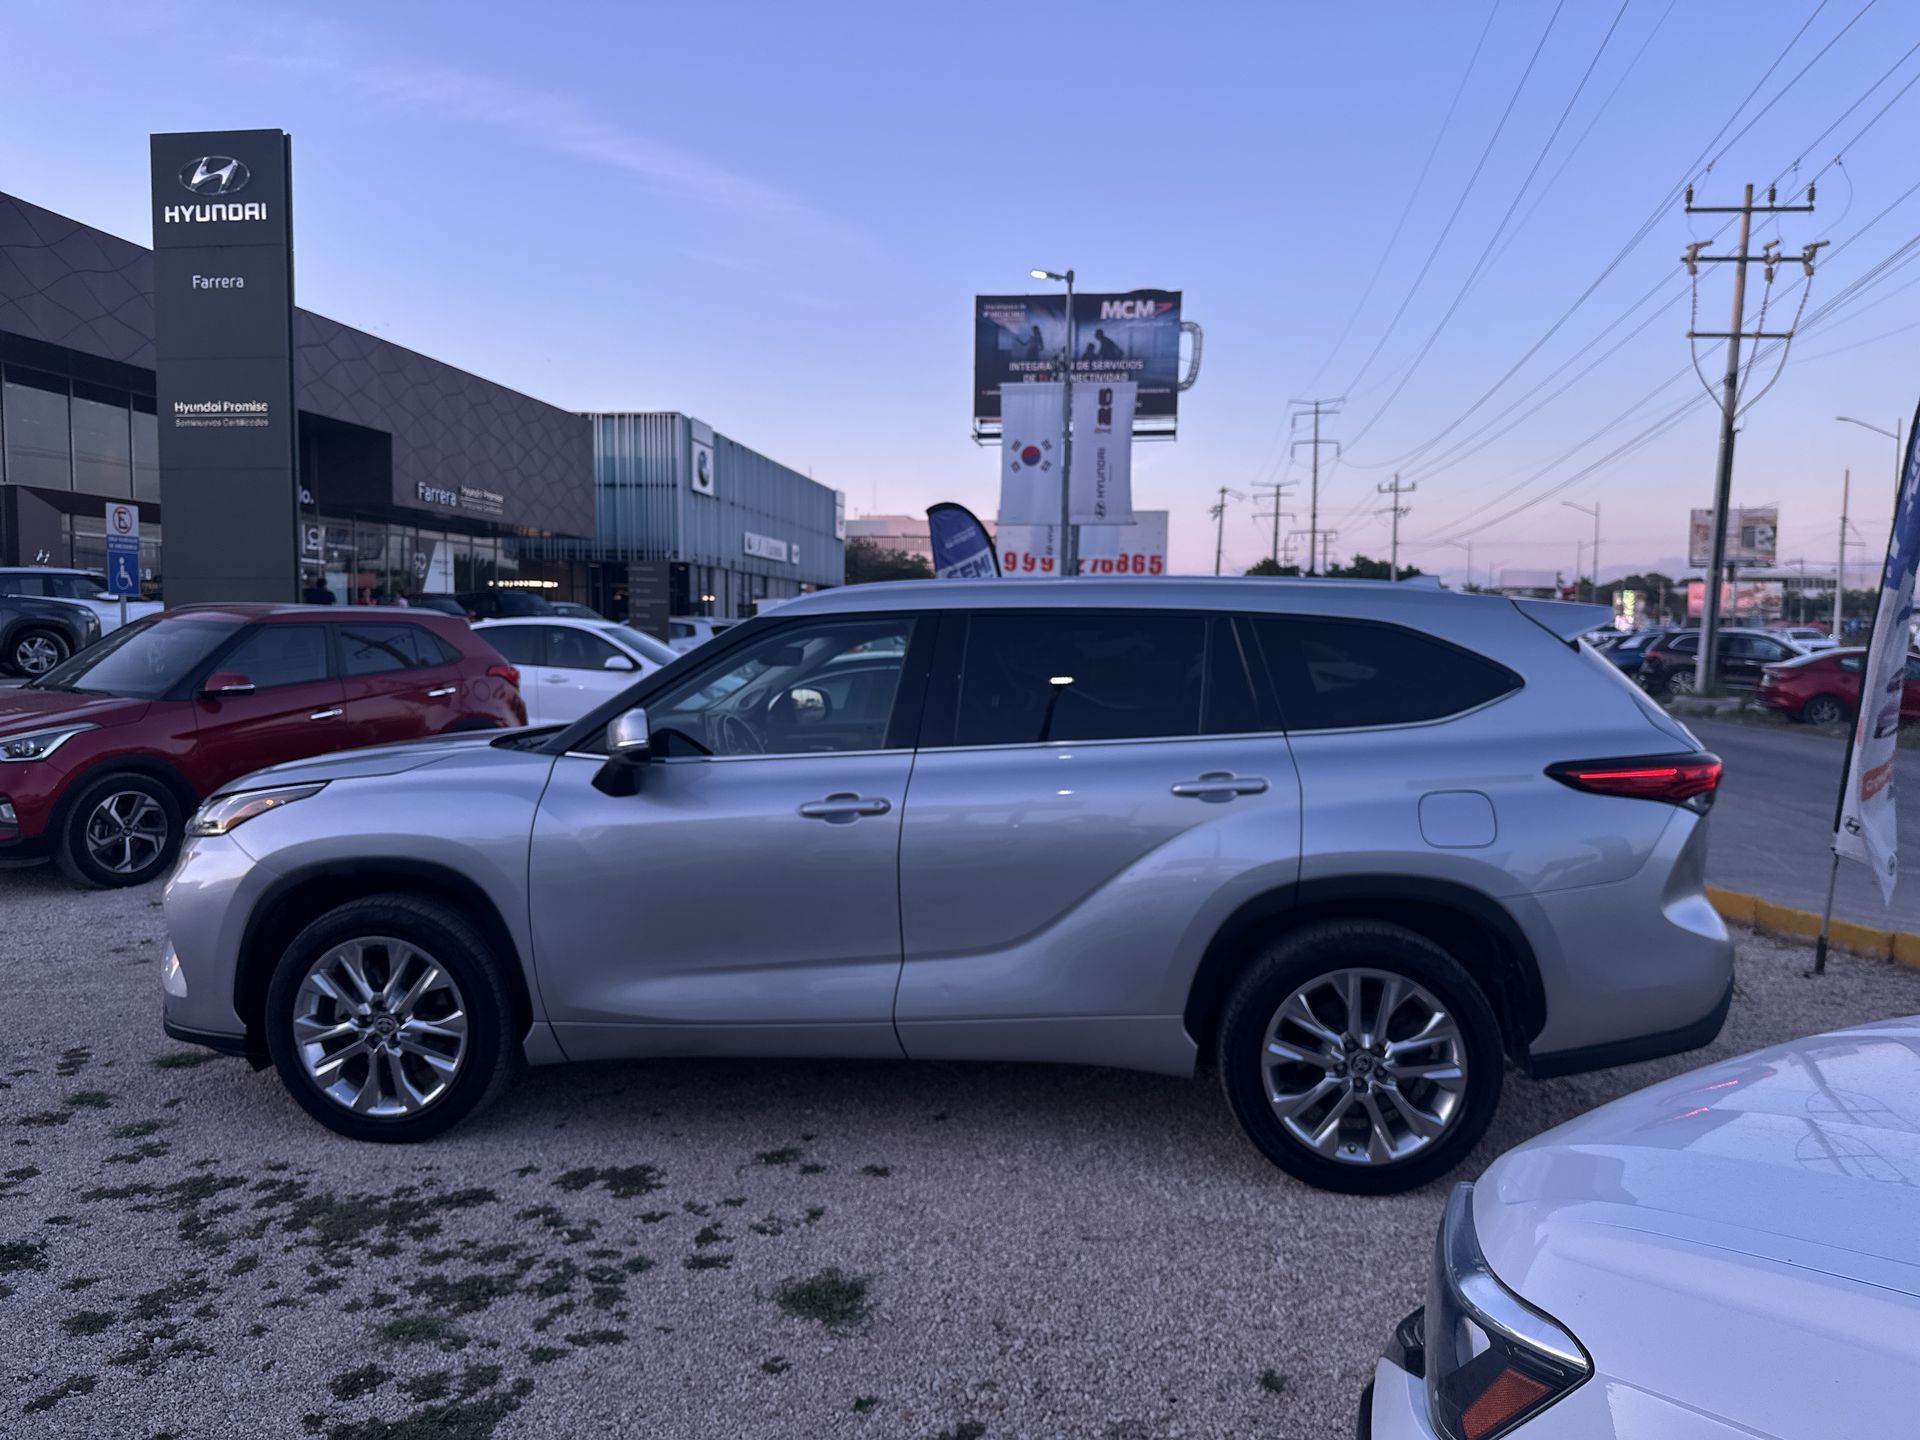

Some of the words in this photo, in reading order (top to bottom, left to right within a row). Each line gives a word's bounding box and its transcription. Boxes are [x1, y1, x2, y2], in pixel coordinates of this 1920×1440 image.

[164, 202, 267, 223] HYUNDAI
[192, 274, 245, 289] Farrera
[1100, 300, 1155, 320] MCM
[1008, 360, 1075, 371] INTEGRA
[1091, 359, 1144, 370] SERVICIOS
[174, 401, 221, 414] Hyundai
[418, 481, 457, 507] Farrera
